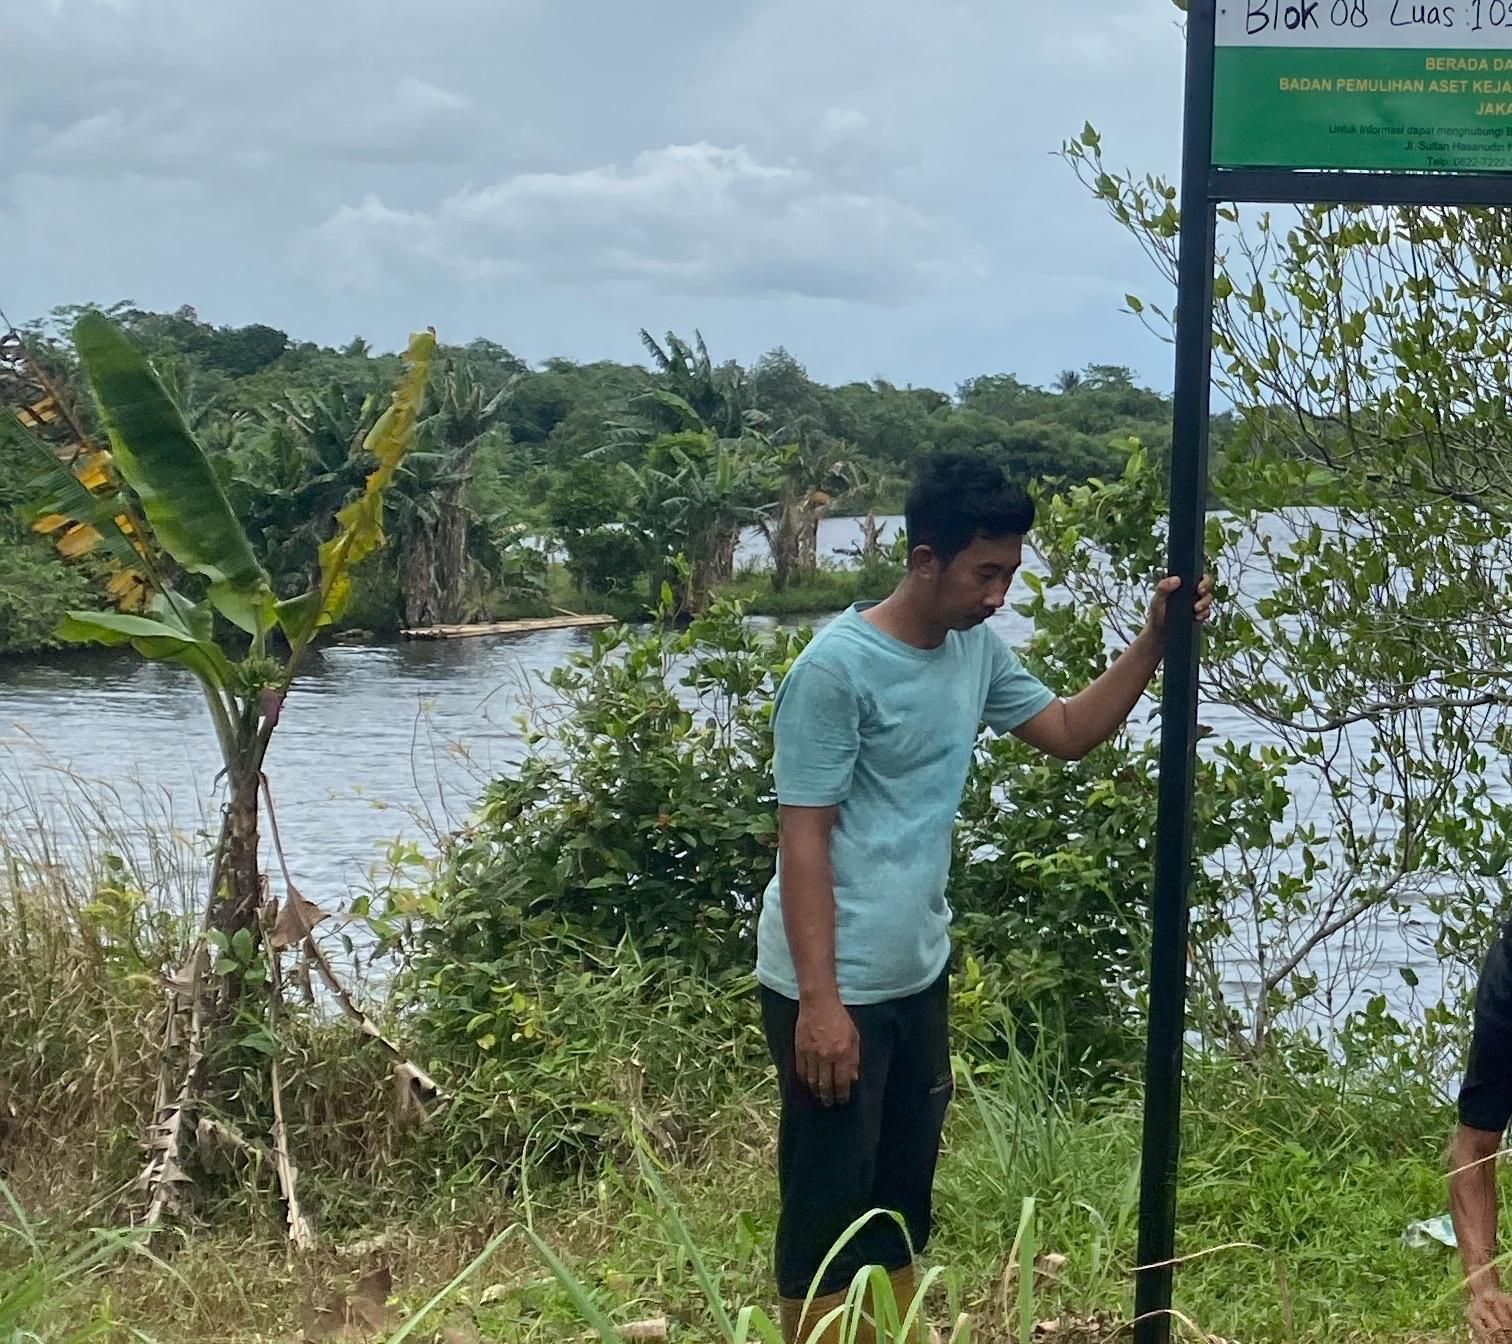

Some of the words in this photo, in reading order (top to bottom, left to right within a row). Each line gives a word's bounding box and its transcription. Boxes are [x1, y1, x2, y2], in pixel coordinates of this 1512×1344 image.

[1424, 57, 1489, 72] BERADA
[1279, 77, 1332, 92] BADAN
[1336, 78, 1425, 93] PEMULIHAN
[1428, 79, 1469, 93] ASET
